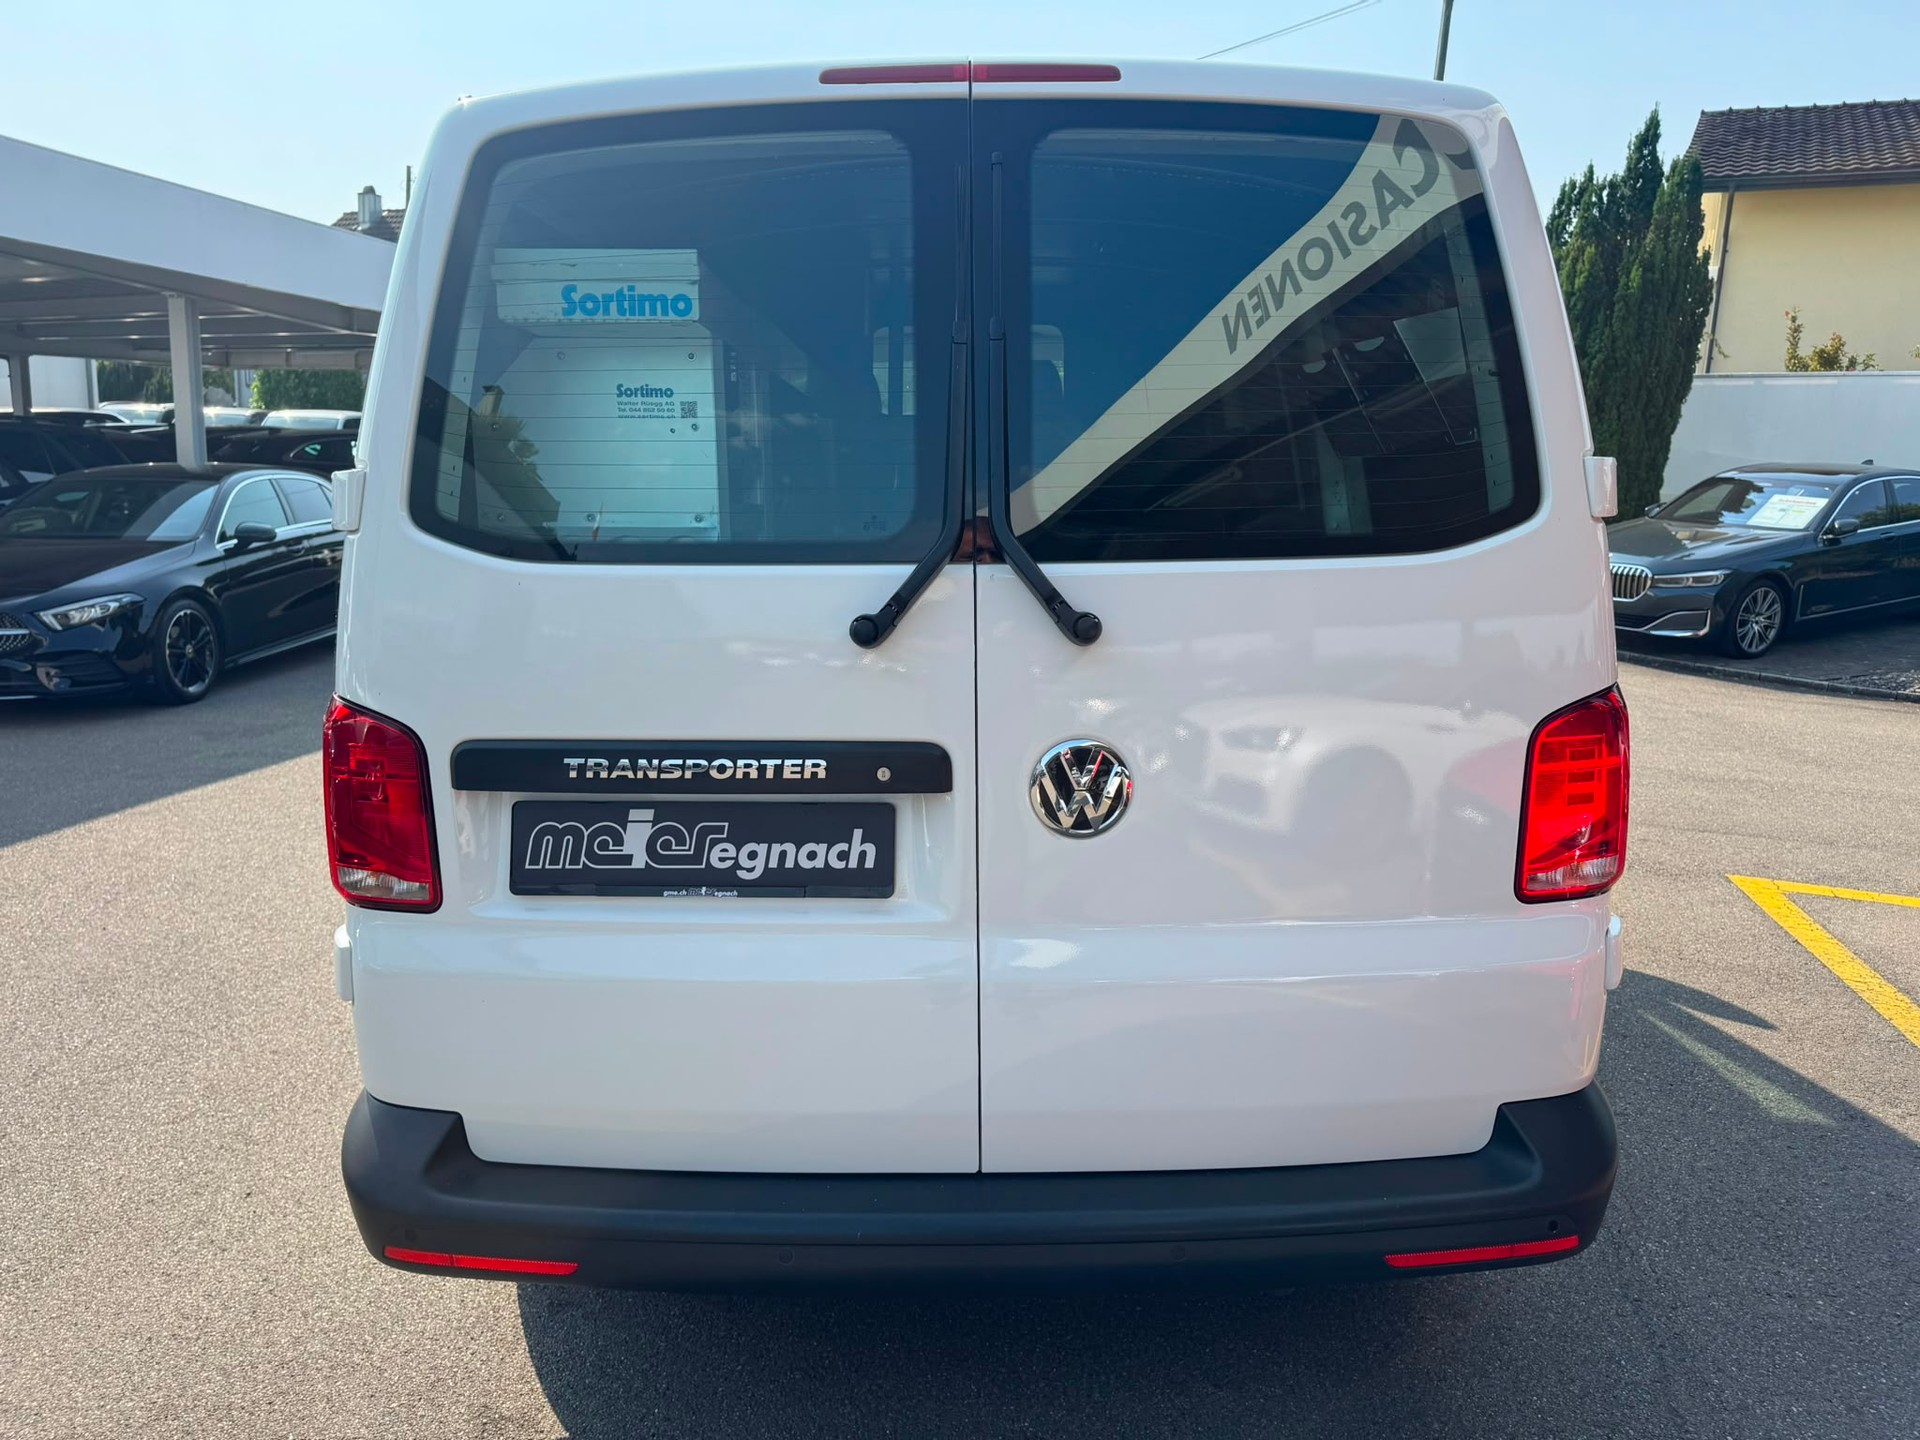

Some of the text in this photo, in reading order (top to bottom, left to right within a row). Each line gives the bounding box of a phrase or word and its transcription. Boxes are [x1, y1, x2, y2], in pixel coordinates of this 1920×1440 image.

[561, 284, 693, 317] Sortimo
[616, 383, 674, 398] Sortimo
[563, 758, 827, 779] TRANSPORTER
